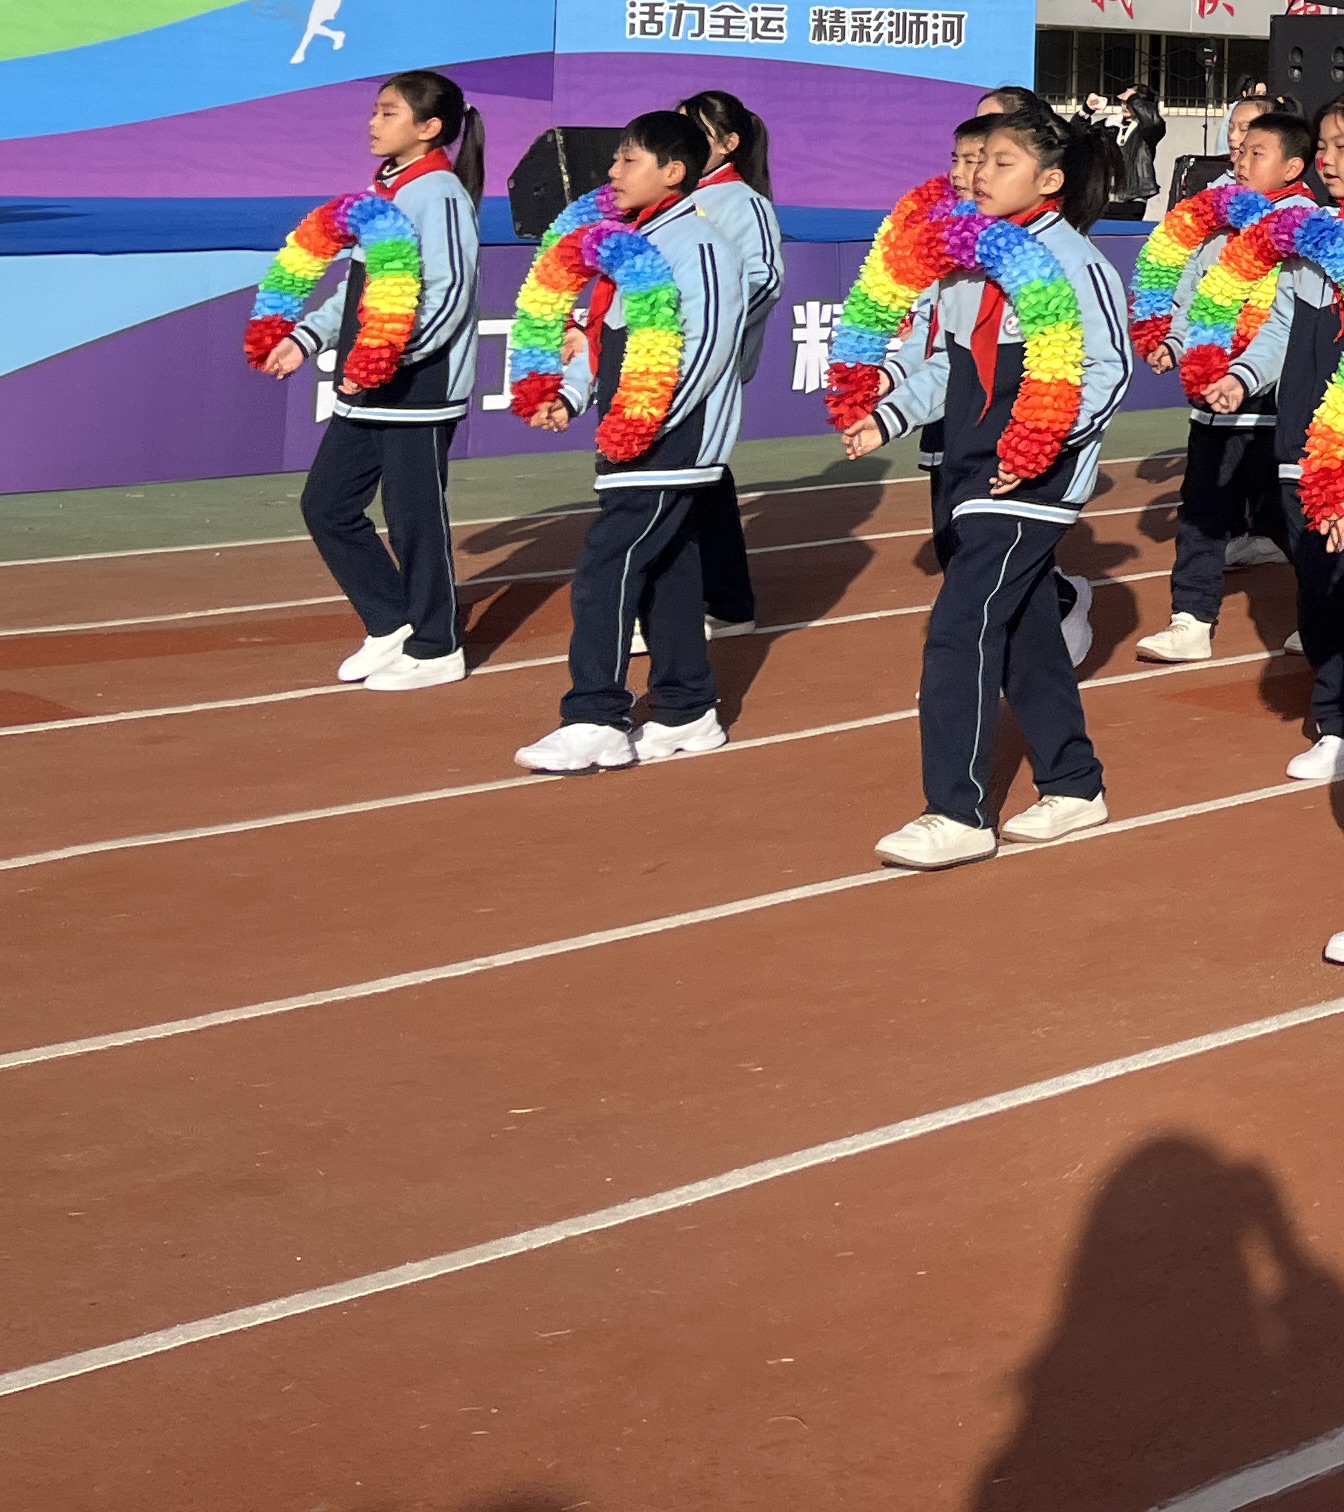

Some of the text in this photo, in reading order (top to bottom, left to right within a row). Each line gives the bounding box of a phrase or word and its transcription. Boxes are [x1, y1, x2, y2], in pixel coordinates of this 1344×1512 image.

[627, 0, 967, 48] 活力全运 精彩浉河
